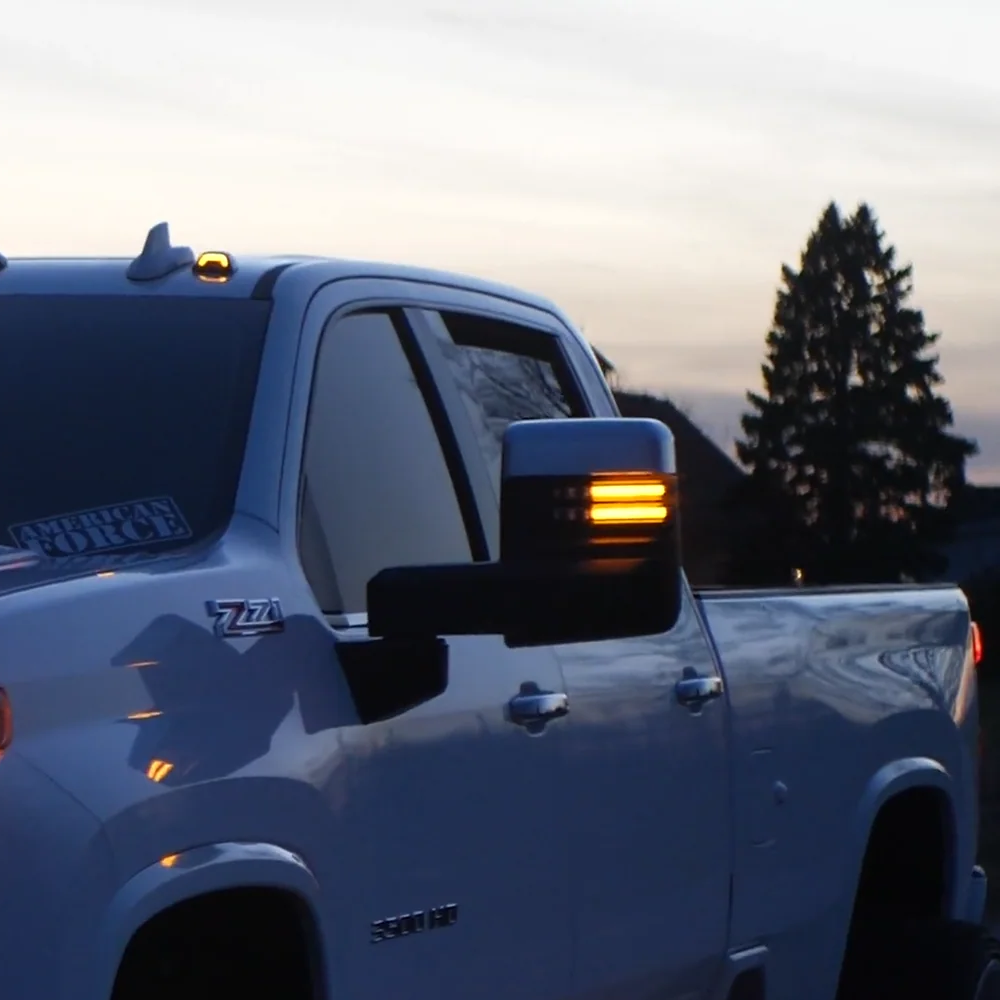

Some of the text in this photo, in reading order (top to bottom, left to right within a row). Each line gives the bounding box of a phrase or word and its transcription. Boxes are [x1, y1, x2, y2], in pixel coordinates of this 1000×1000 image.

[20, 500, 174, 542] AMERICAN
[24, 514, 186, 554] FORCE
[205, 599, 284, 637] Z71
